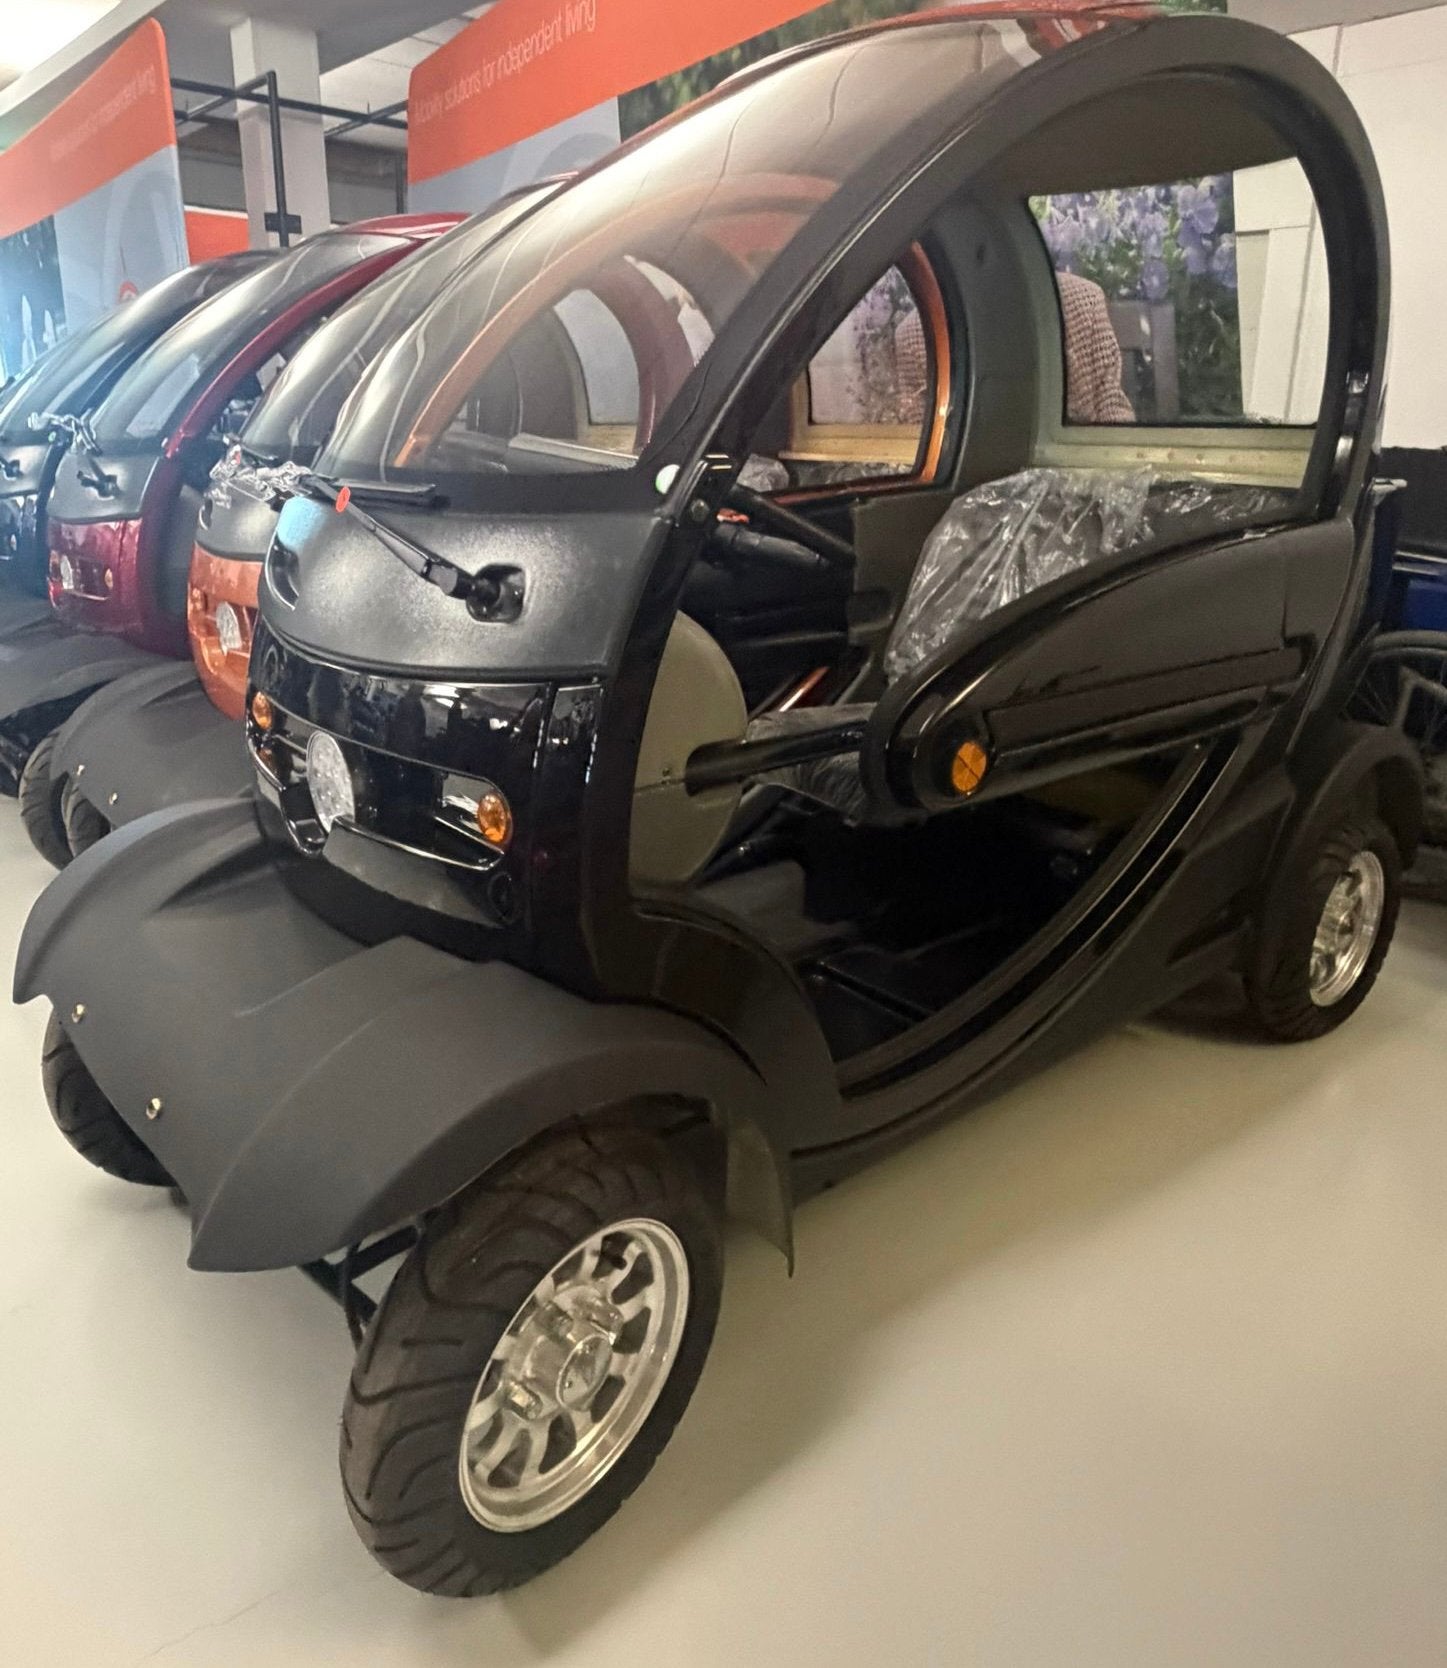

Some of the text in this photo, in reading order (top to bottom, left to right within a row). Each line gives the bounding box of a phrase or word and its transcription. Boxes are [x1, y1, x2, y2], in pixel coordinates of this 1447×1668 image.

[482, 59, 496, 87] for
[496, 11, 563, 80] independent
[564, 0, 597, 37] living
